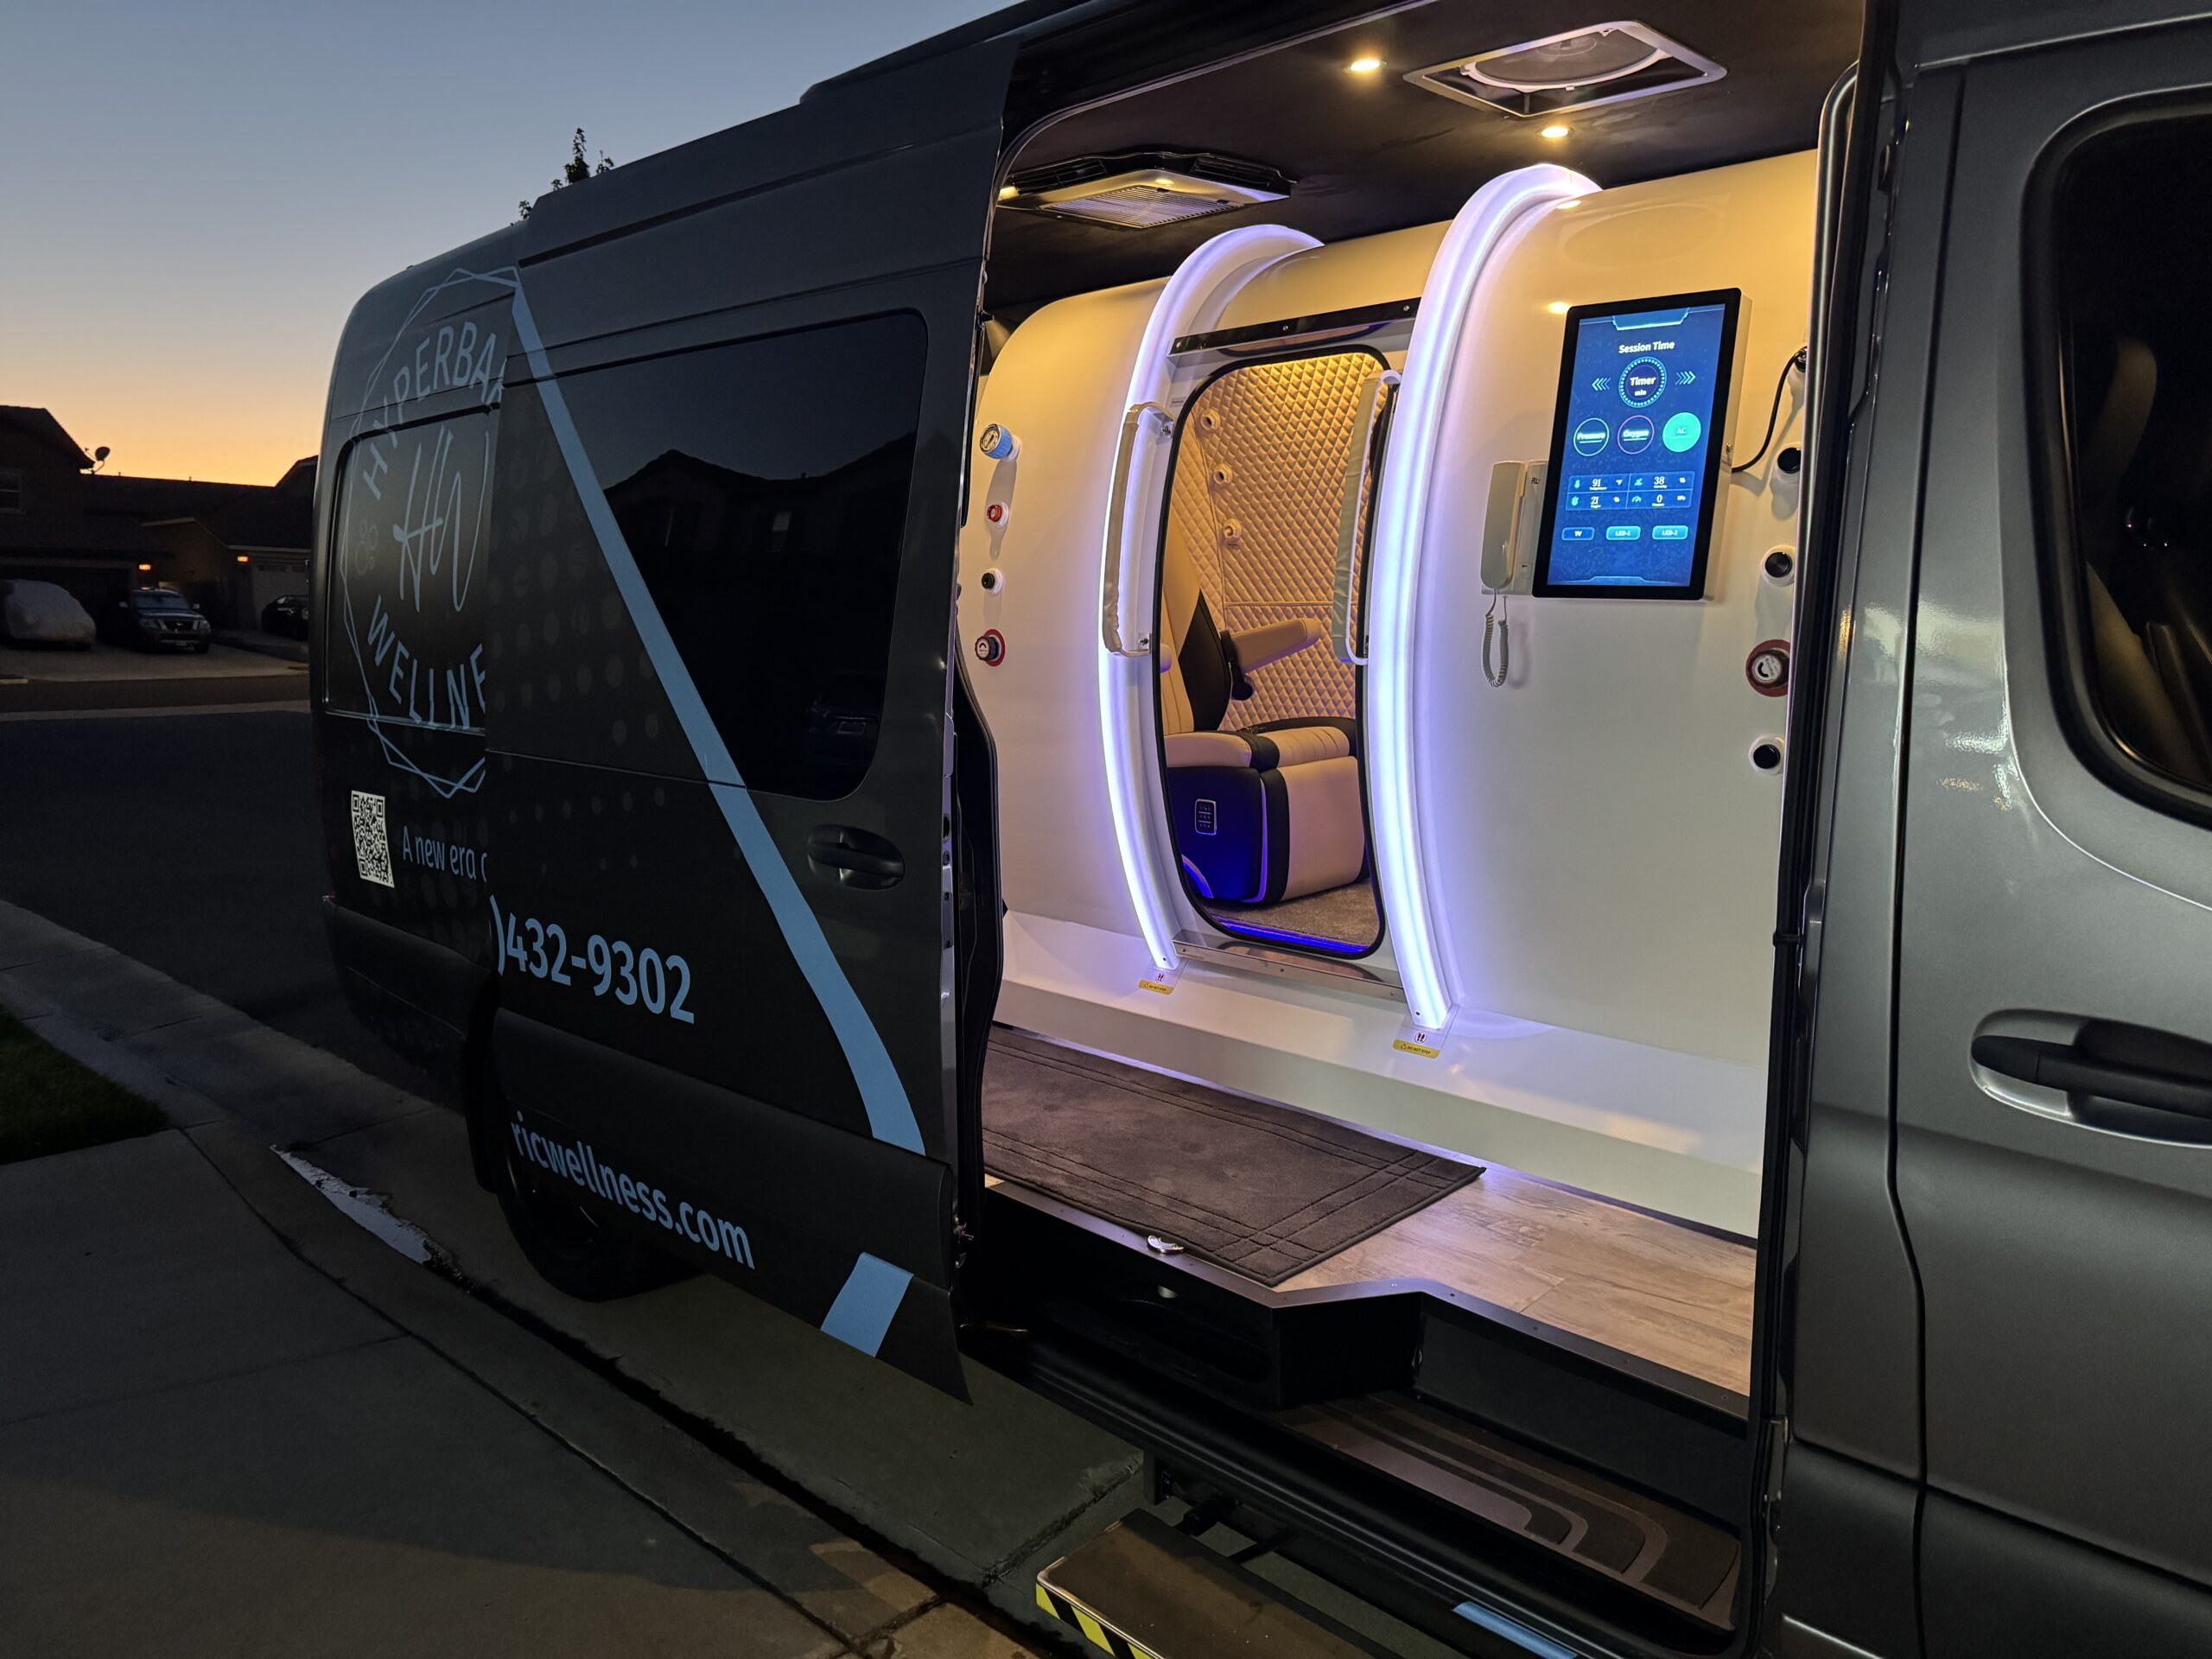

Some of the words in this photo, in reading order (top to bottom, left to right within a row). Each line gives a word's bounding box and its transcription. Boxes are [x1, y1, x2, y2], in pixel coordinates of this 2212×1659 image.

[1618, 343, 1651, 353] Session
[1653, 340, 1675, 351] Time
[1630, 377, 1656, 386] Timer
[1592, 478, 1601, 487] 91
[1654, 476, 1665, 485] 38
[1591, 496, 1599, 505] 21
[1656, 494, 1663, 503] 0
[403, 825, 414, 862] A
[415, 836, 445, 871] new
[449, 844, 477, 880] era
[489, 894, 695, 1025] )432-9302
[511, 1110, 755, 1269] ricwellness.com
